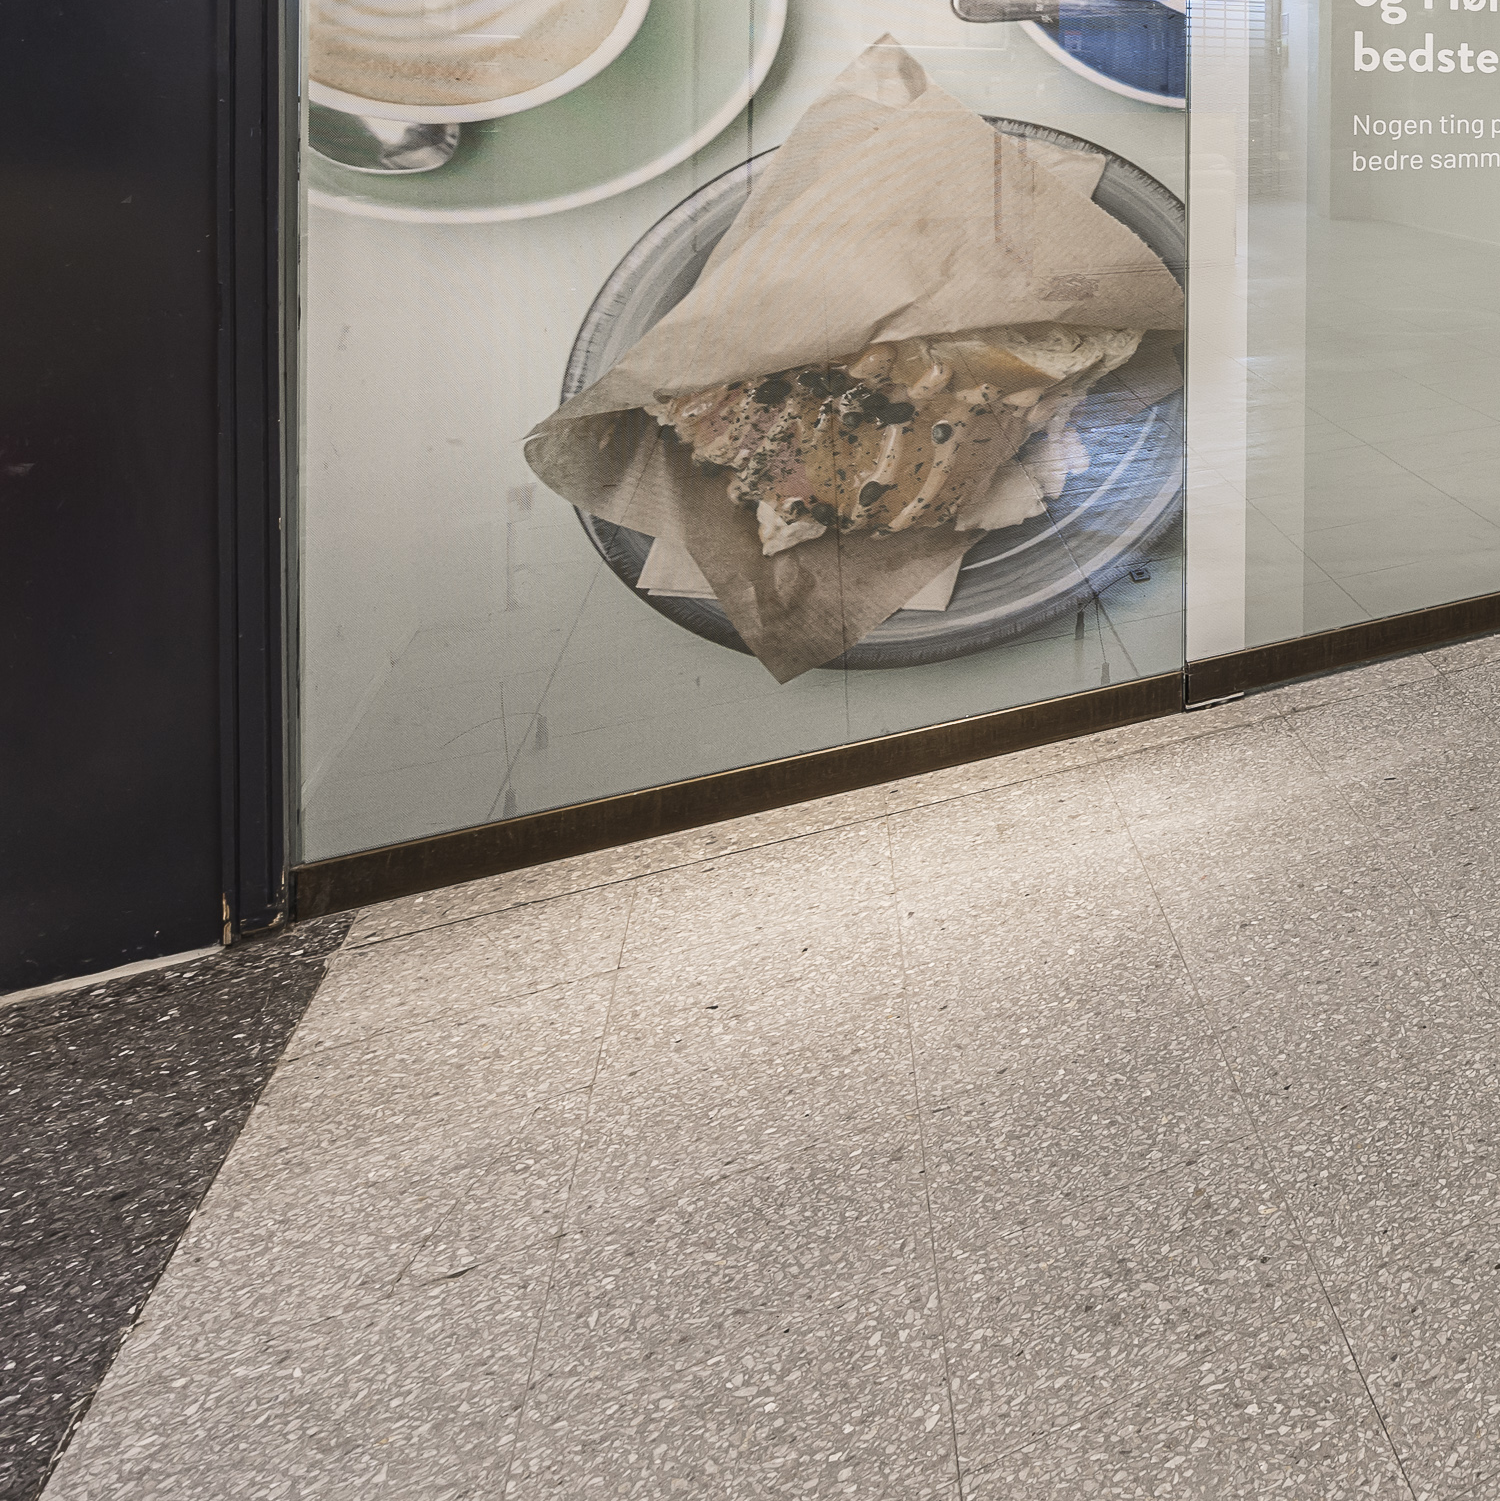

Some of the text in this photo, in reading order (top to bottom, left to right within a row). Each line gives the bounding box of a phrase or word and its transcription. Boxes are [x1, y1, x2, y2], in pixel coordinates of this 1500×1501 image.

[1354, 31, 1499, 73] bedste
[1353, 114, 1433, 140] Nogen
[1439, 114, 1484, 138] ting
[1353, 150, 1423, 171] bedre
